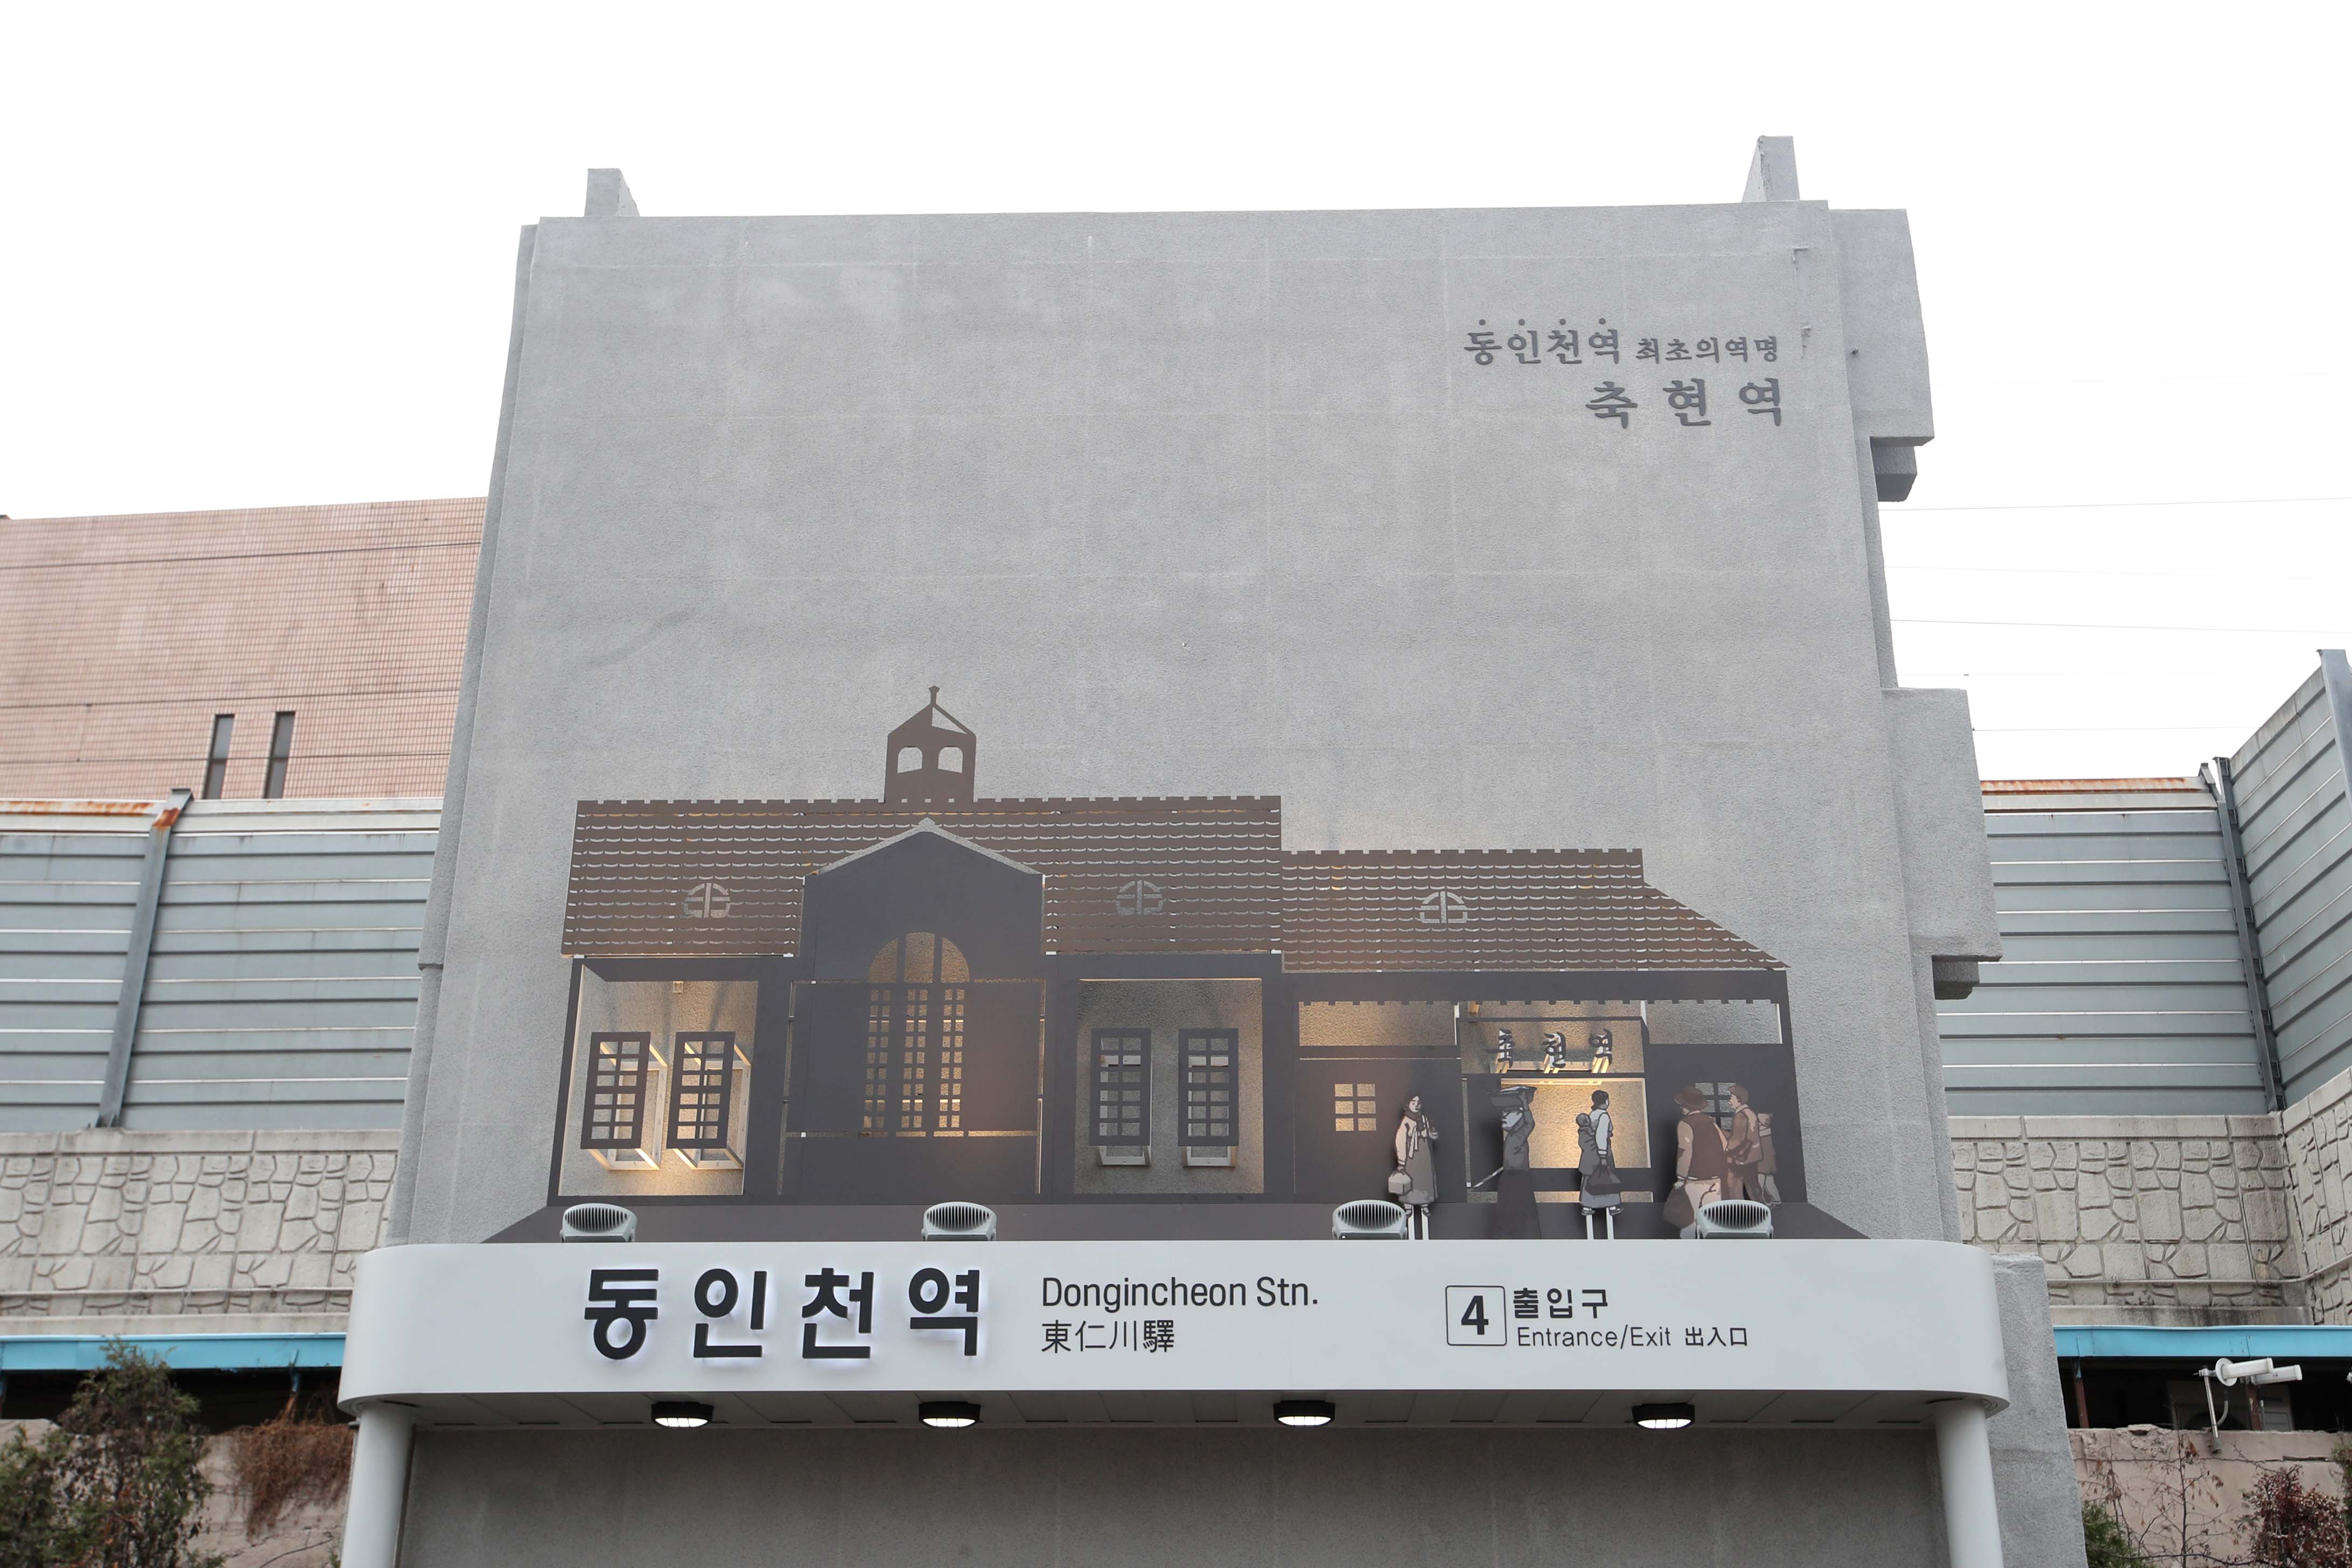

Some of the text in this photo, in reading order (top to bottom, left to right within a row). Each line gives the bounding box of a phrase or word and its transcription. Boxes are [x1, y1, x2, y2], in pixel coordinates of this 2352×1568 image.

[1464, 328, 1620, 366] 동인천역
[1585, 377, 1782, 429] 축현역
[1042, 1276, 1318, 1313] Dongincheon Stn.
[1513, 1287, 1608, 1319] 출입구
[584, 1268, 980, 1360] 동인천역
[1461, 1295, 1489, 1335] 4
[1041, 1319, 1175, 1354] 東仁川驛
[1517, 1325, 1748, 1349] Entrance/Exit 出入口
